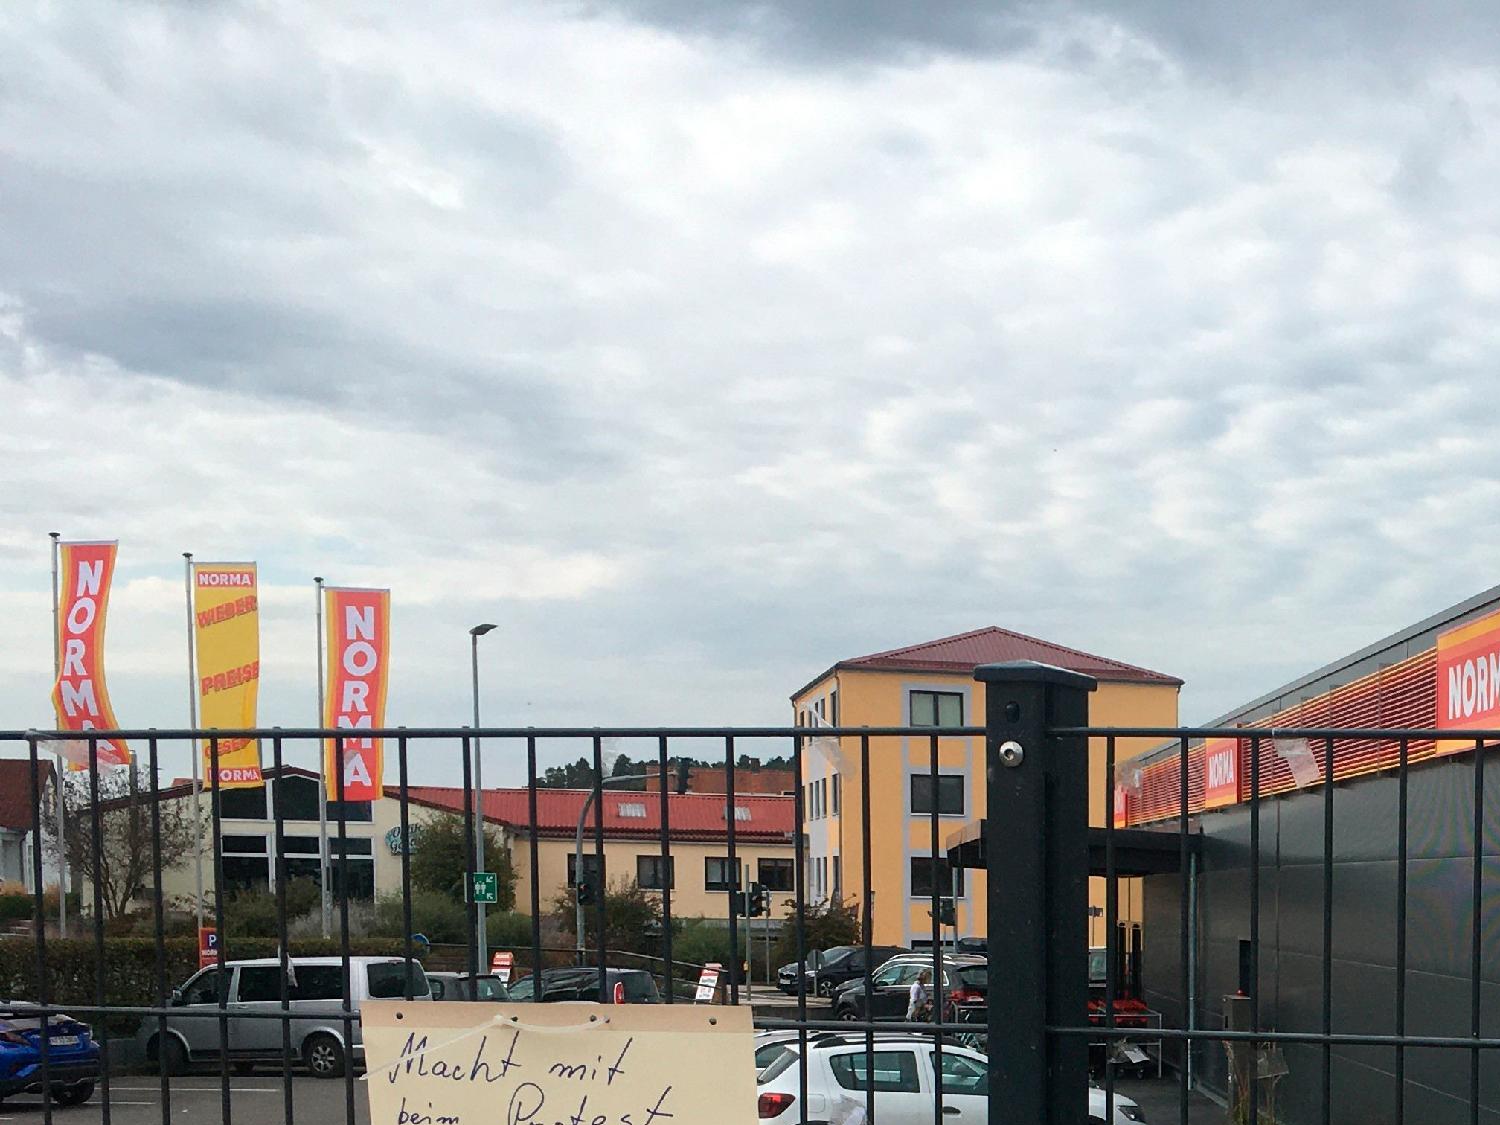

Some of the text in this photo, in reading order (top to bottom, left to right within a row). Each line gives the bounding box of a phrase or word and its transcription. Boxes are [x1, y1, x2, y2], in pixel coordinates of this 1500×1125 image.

[199, 573, 251, 585] NORMA
[338, 606, 377, 787] NORMA
[209, 769, 258, 782] ORMA
[1209, 749, 1234, 789] NORMA
[209, 934, 217, 946] P
[389, 1031, 633, 1086] Macht mit
[398, 1097, 460, 1125] beim
